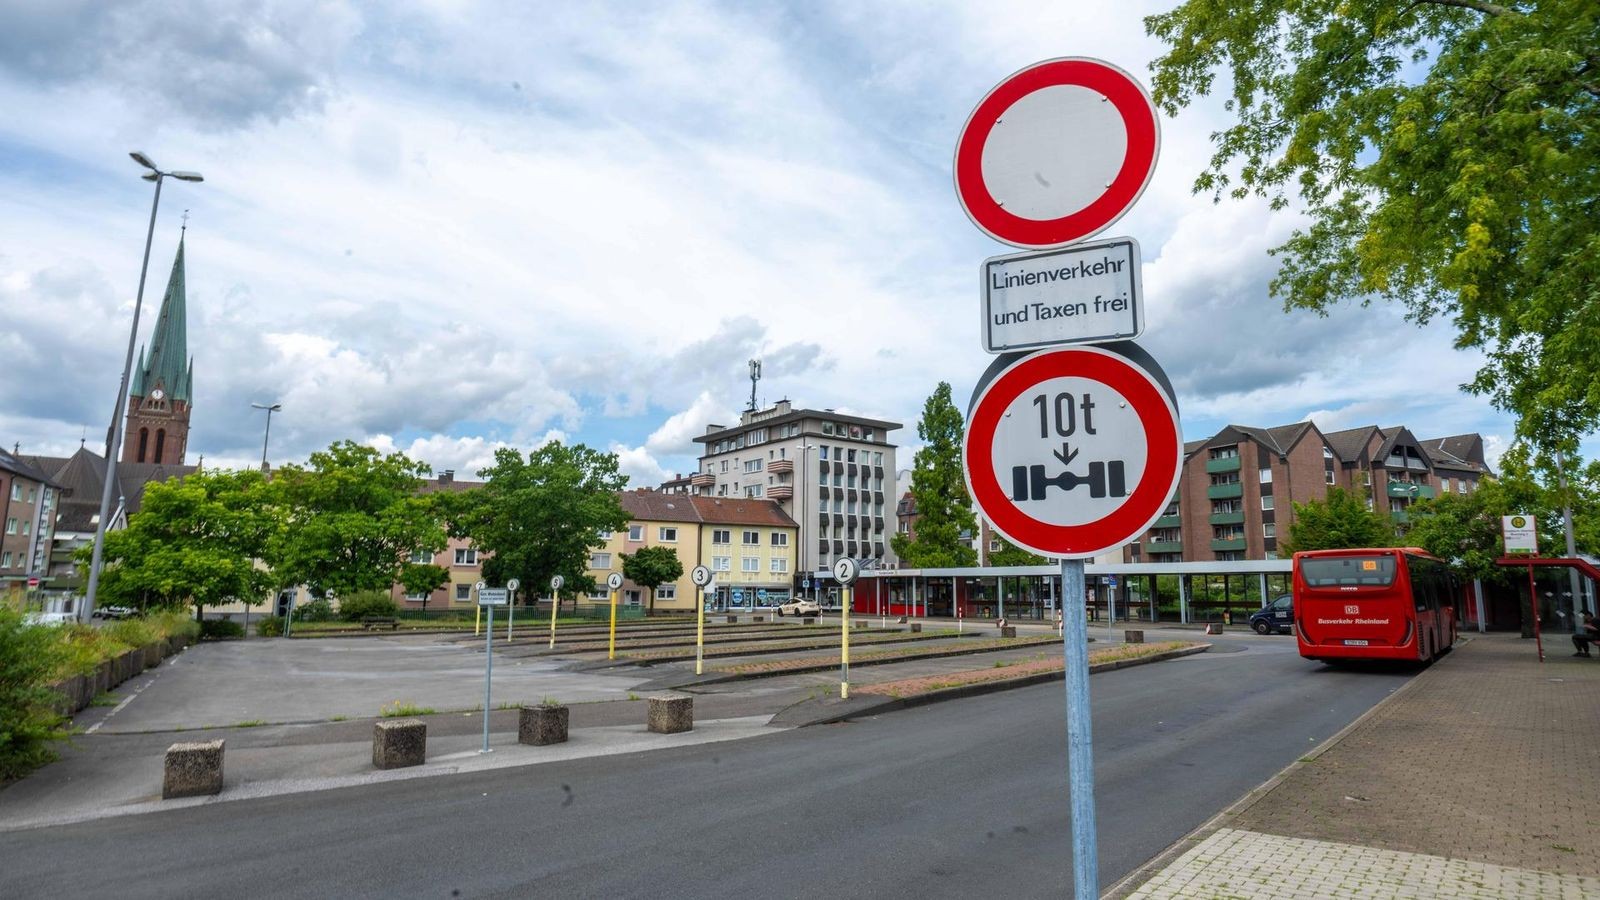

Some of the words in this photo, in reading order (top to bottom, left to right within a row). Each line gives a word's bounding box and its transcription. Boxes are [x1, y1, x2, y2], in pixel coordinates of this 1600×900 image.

[993, 257, 1125, 290] Linienverkehr
[994, 305, 1028, 326] und
[1031, 302, 1087, 321] Taxen
[1094, 293, 1128, 313] frei
[697, 570, 704, 581] 3
[840, 563, 848, 578] 2
[510, 581, 515, 589] 6
[554, 579, 559, 587] 5
[611, 577, 617, 586] 4
[1345, 605, 1359, 614] DB
